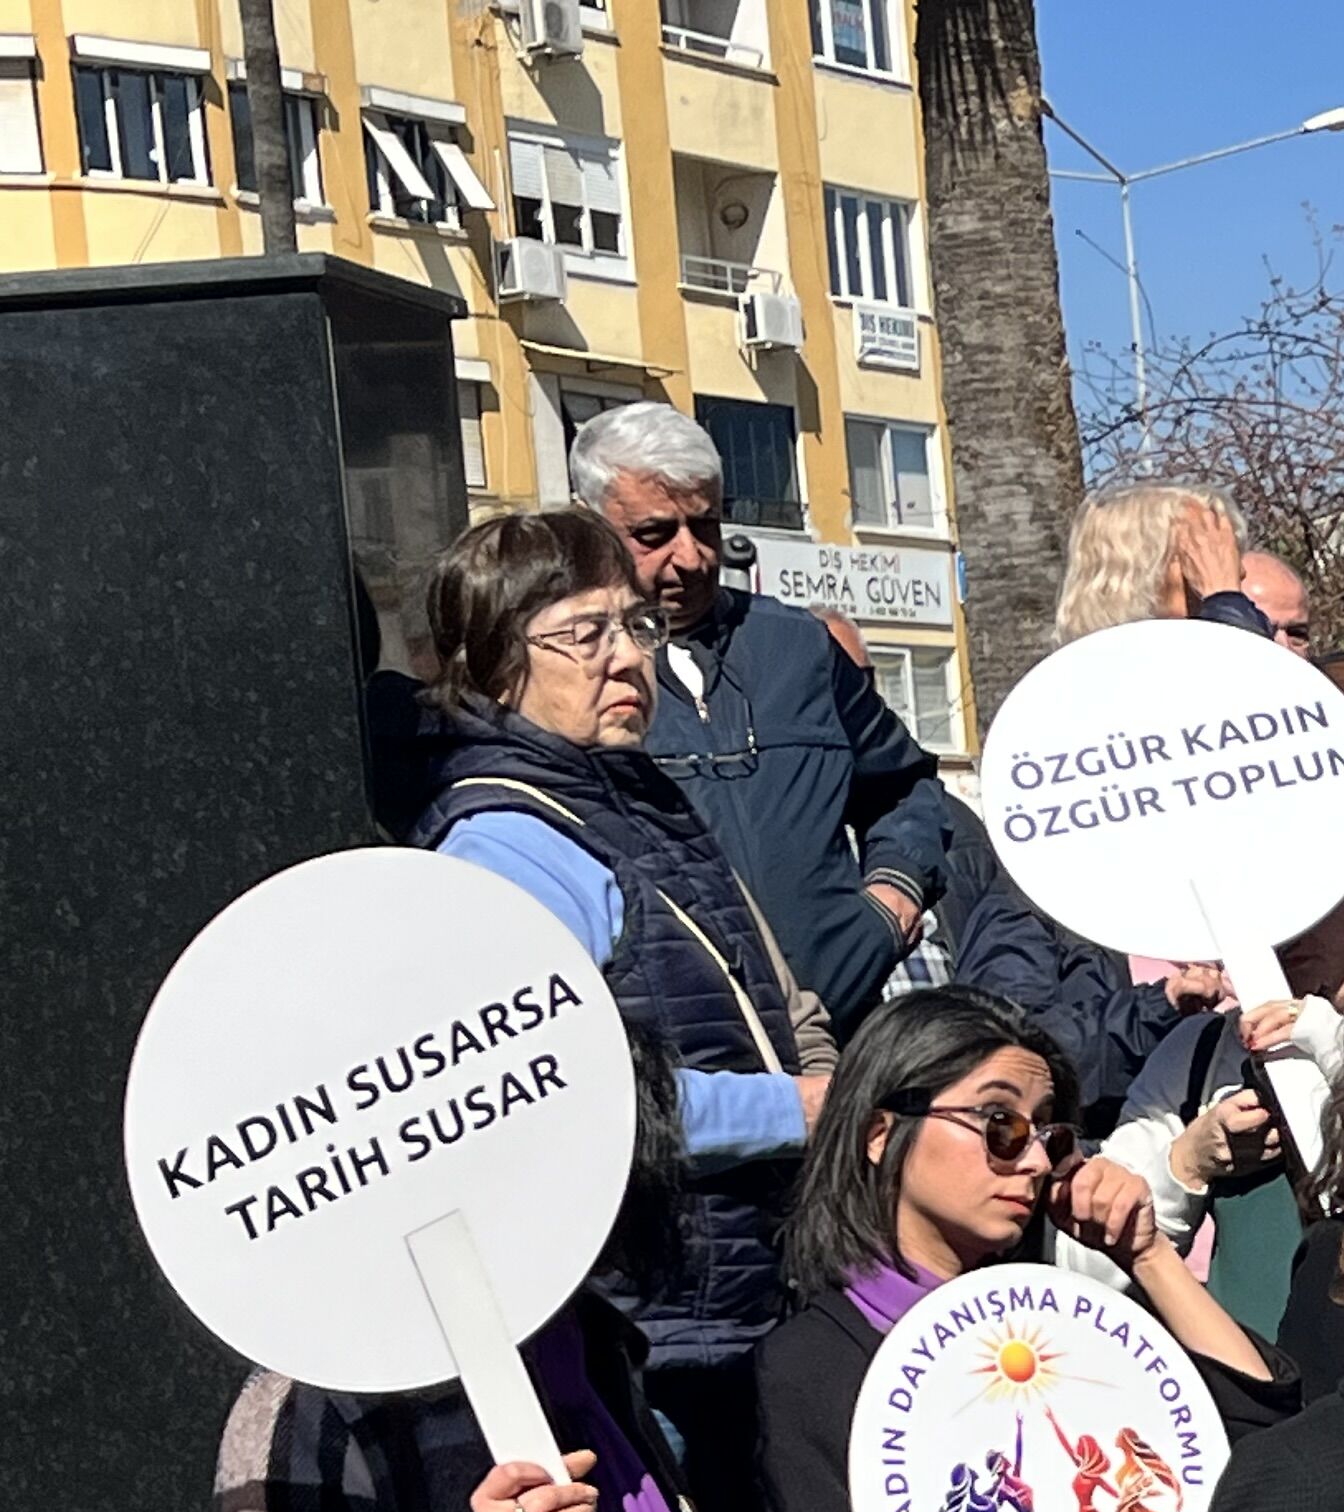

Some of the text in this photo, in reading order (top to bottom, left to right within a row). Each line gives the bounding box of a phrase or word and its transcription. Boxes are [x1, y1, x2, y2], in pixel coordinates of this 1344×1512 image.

[779, 569, 942, 608] SEMRA GÜVEN
[1011, 702, 1329, 789] ÖZGÜR KADIN
[1004, 787, 1165, 842] ÖZGÜR
[157, 973, 583, 1199] KADIN SUSARSA
[224, 1054, 568, 1240] TARİH SUSAR
[888, 1287, 1057, 1413] DAYANIŞMA
[1074, 1296, 1201, 1485] PLATFORMU
